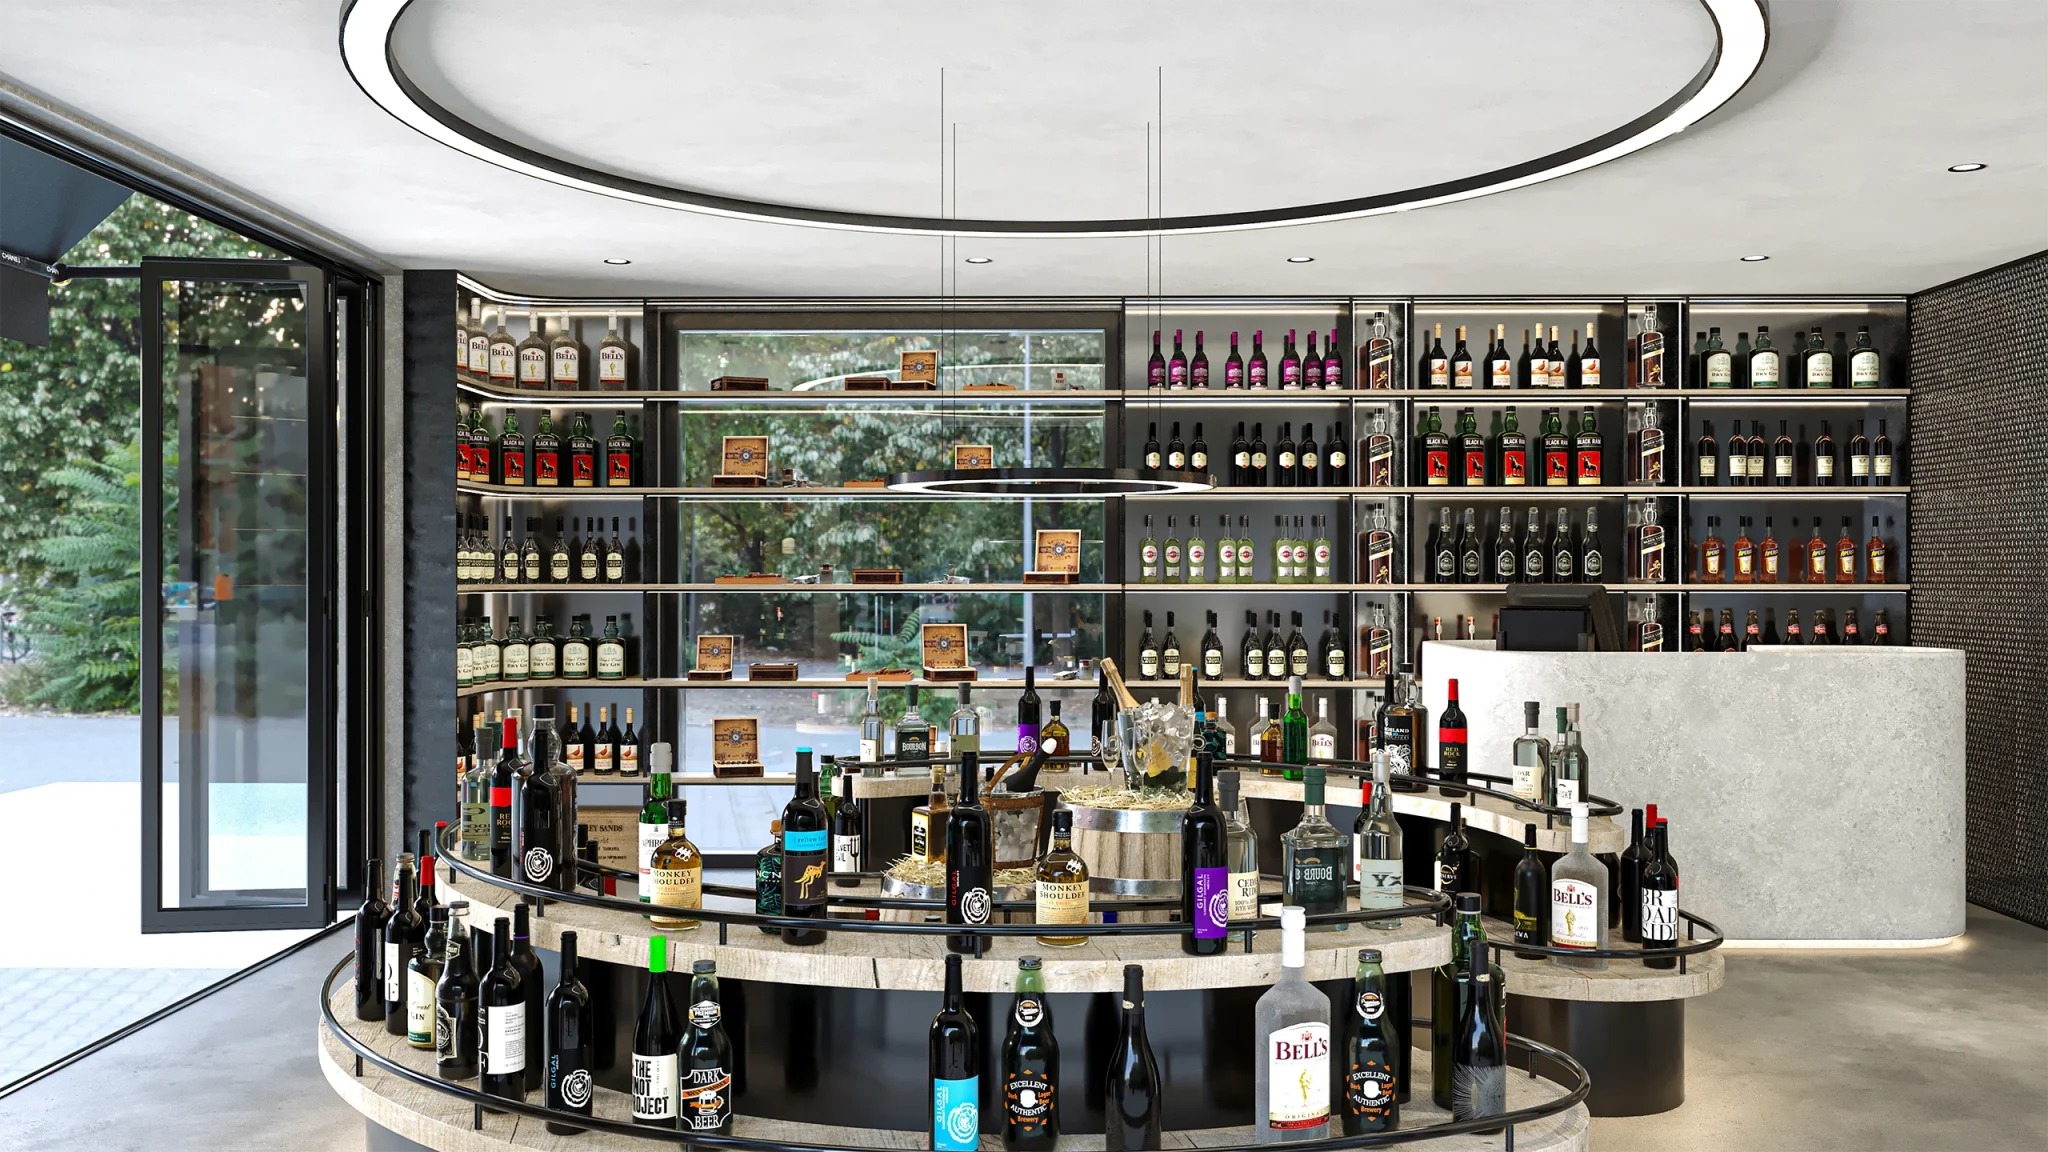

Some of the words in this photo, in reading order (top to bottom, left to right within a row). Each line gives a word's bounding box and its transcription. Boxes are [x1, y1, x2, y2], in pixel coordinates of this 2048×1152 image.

[902, 741, 927, 752] BOURBON
[600, 824, 623, 832] SANDS
[1042, 883, 1083, 892] MONKEY
[1040, 891, 1086, 900] SHOULDER
[1553, 888, 1593, 906] BELL'S
[1642, 889, 1663, 906] BR
[1275, 1037, 1328, 1061] BELL'S
[634, 1059, 652, 1079] THE
[693, 1070, 720, 1084] DARK
[1352, 1071, 1391, 1082] EXCELLENT
[1009, 1080, 1048, 1091] EXCELLENT
[1350, 1082, 1361, 1090] Dark
[1007, 1092, 1018, 1100] Dark
[1353, 1094, 1390, 1107] AUTHENTIC
[1010, 1103, 1048, 1116] AUTHENTIC
[1360, 1105, 1383, 1114] Brewery
[694, 1115, 720, 1129] BEER
[1017, 1115, 1039, 1124] Brewery
